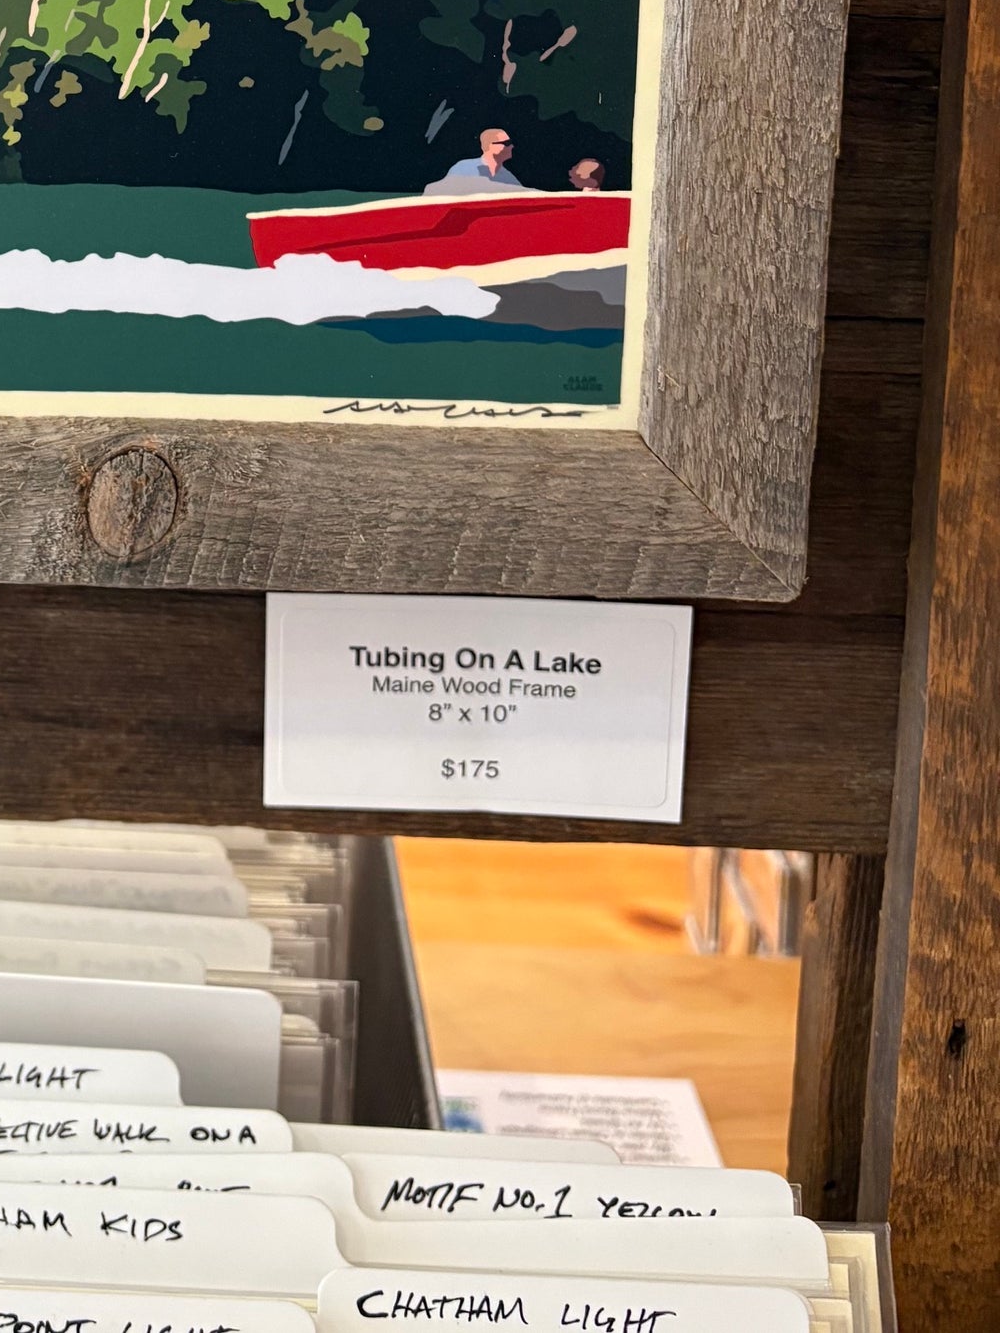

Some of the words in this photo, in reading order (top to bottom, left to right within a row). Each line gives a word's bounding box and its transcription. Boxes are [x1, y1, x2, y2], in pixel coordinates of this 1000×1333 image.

[348, 645, 446, 675] Tubing
[454, 647, 495, 670] On
[503, 649, 526, 671] A
[533, 650, 603, 675] Lake
[372, 675, 435, 694] Maine
[442, 676, 501, 695] Wood
[508, 678, 577, 699] Frame
[458, 707, 472, 723] x
[441, 758, 500, 780] $175
[92, 1118, 171, 1145] WALK
[189, 1126, 232, 1144] ON
[237, 1124, 257, 1146] A
[99, 1211, 184, 1243] KIDS
[355, 1289, 529, 1326] CHATHAM
[560, 1302, 677, 1333] LIGHT
